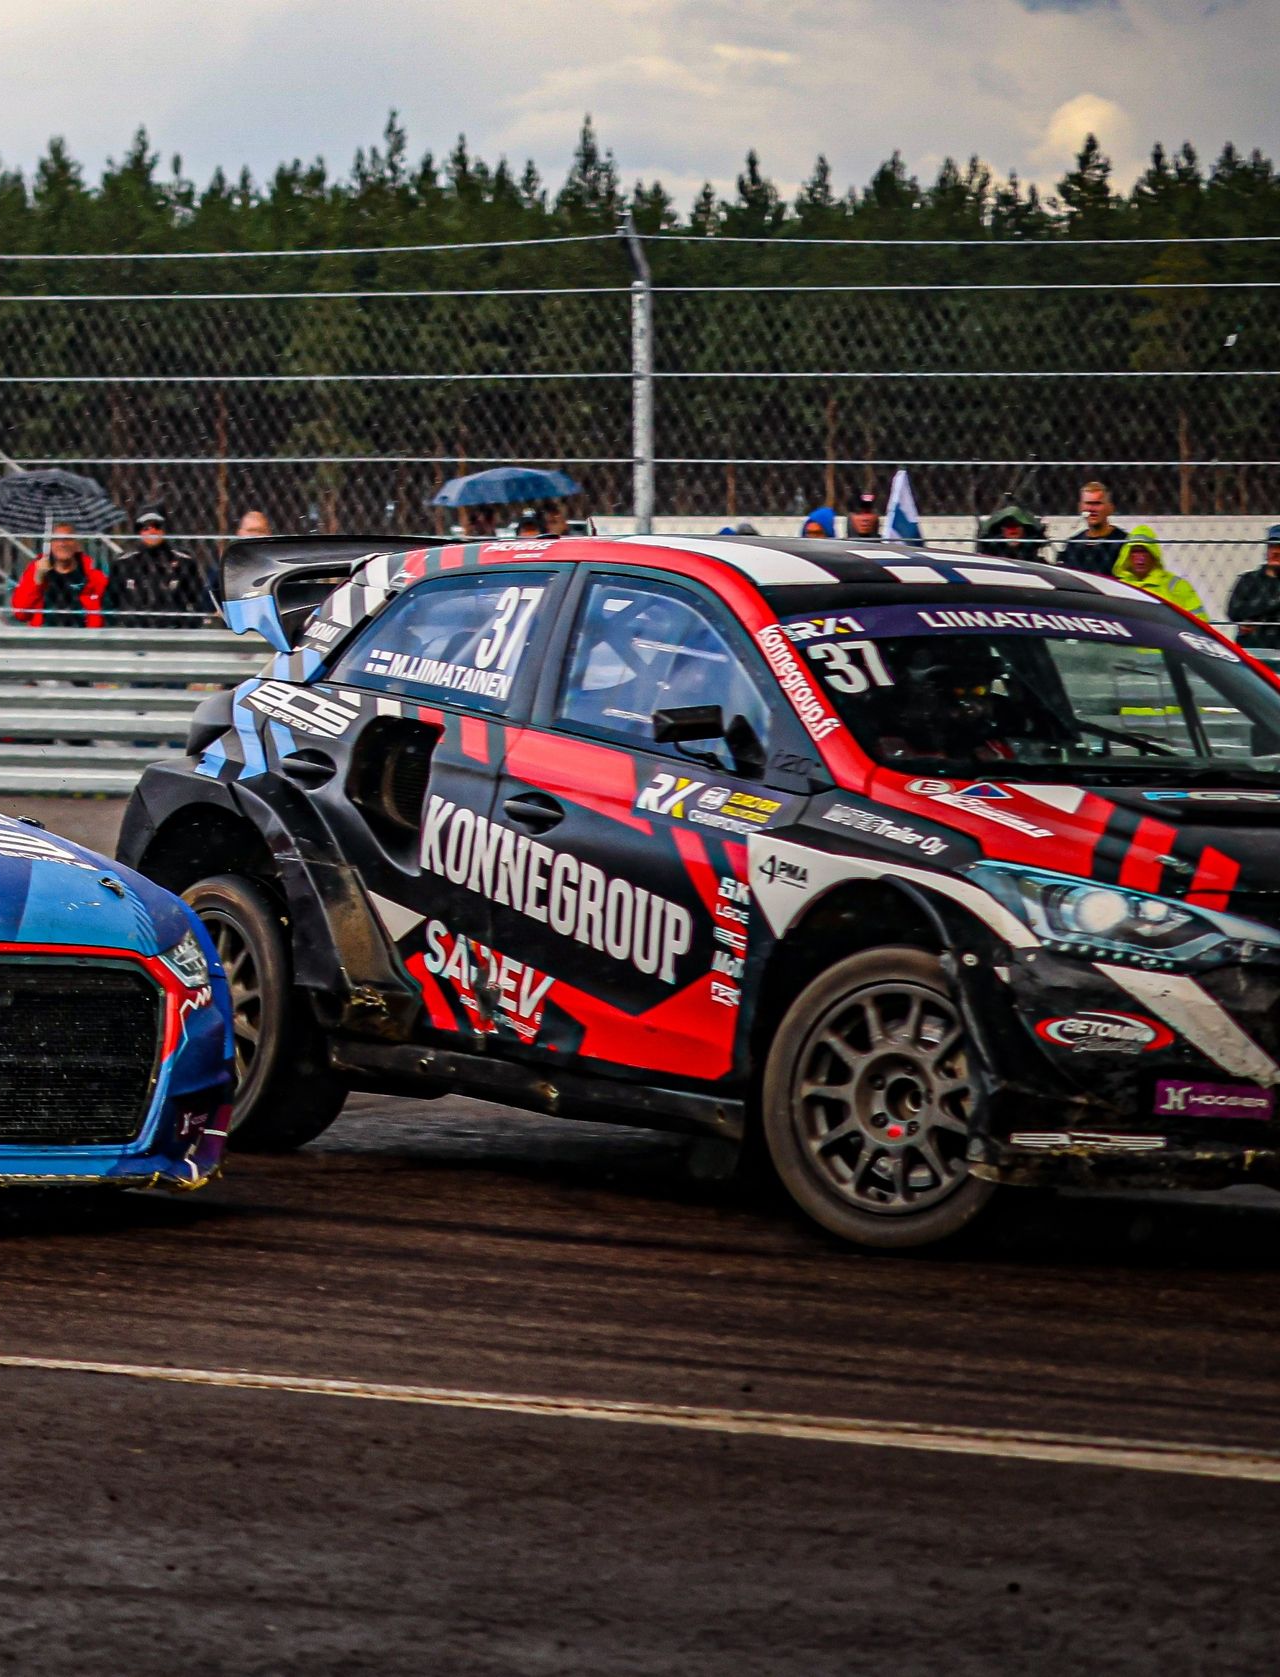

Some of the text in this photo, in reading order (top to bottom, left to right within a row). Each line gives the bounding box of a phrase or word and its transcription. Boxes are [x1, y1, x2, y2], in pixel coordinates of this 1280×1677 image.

[474, 585, 545, 671] 37
[916, 611, 1134, 638] LIIMATAINEN
[387, 653, 513, 701] M.LIIMATAINEN
[806, 640, 896, 694] 37
[636, 772, 706, 819] RX
[918, 835, 950, 856] Oy
[419, 794, 693, 985] KONNEGROUP
[1188, 1093, 1269, 1109] HOOSIER
